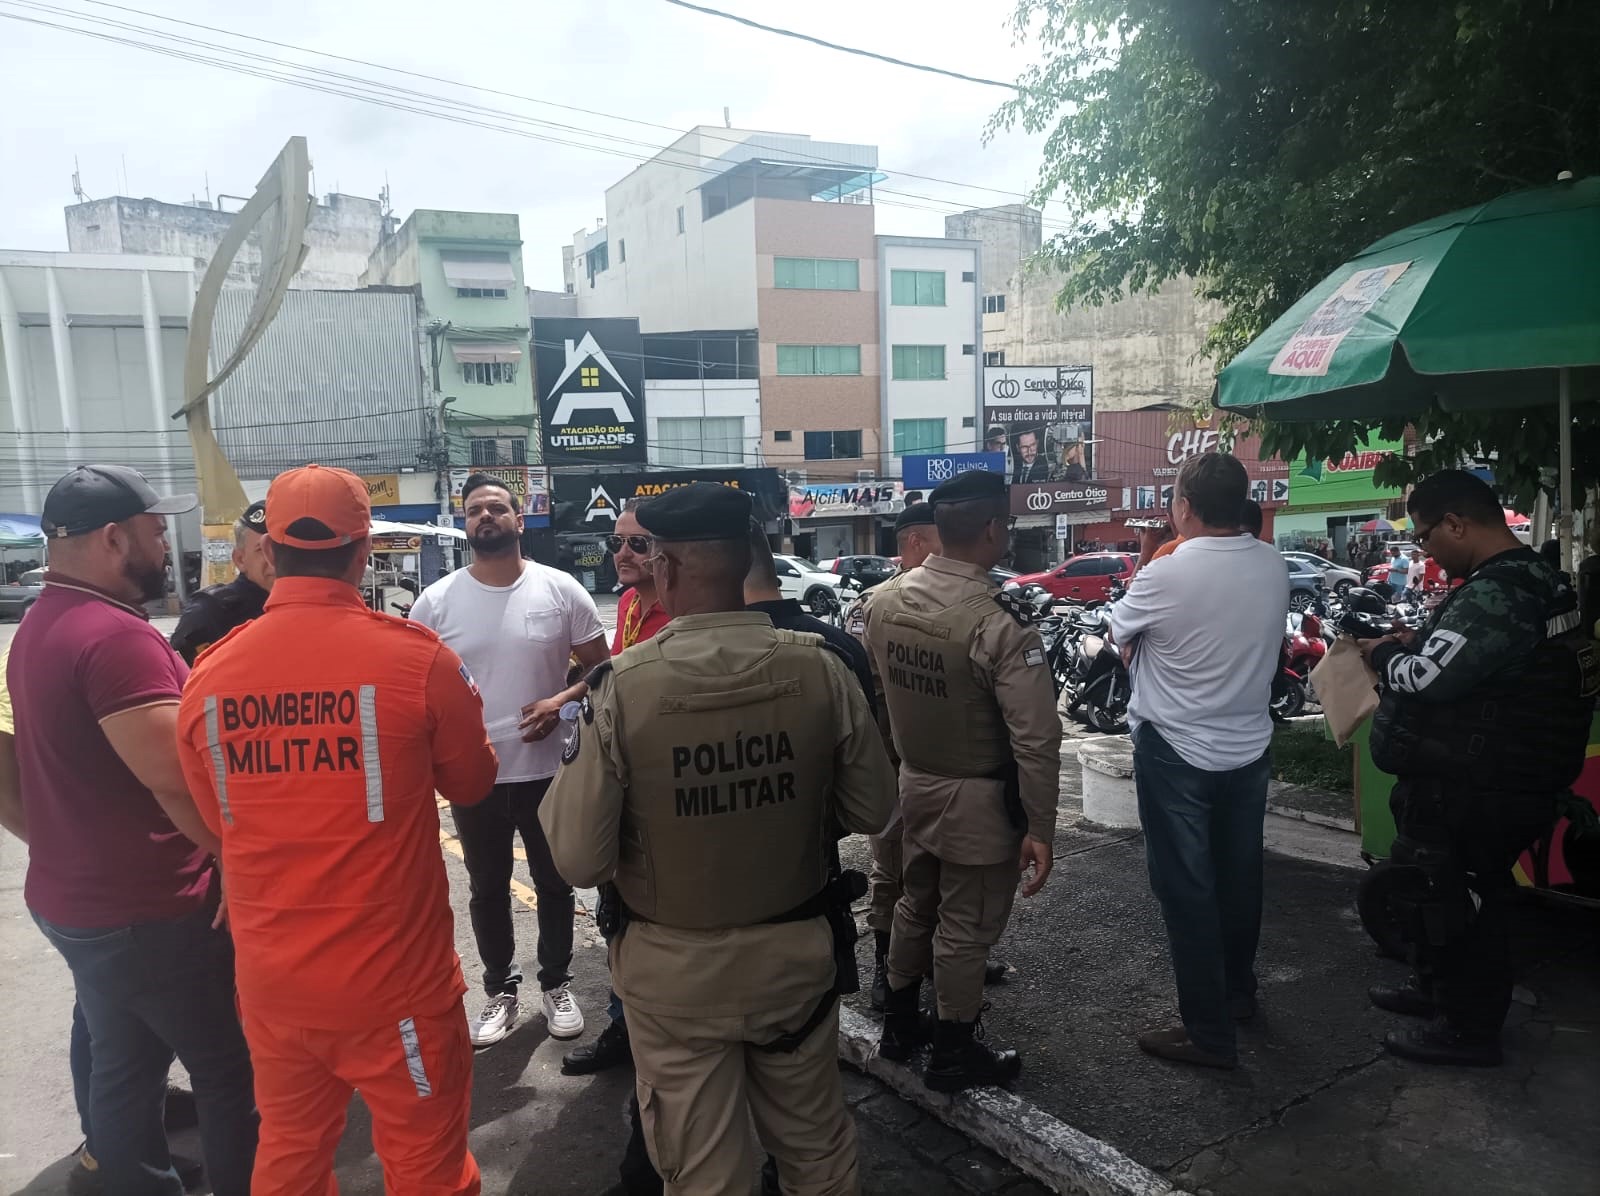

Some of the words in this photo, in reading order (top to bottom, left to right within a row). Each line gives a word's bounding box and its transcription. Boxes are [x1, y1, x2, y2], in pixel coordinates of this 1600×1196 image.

[1024, 378, 1056, 389] Centro
[991, 410, 997, 422] A
[998, 411, 1012, 421] sua
[1014, 408, 1033, 421] ótica
[1034, 412, 1040, 421] a
[560, 425, 607, 435] ATACADÃO
[608, 425, 626, 433] DAS
[550, 433, 635, 447] UTILIDADES
[927, 458, 953, 471] PRO
[957, 460, 989, 470] CLÍNICA
[927, 469, 953, 480] ENDO
[840, 486, 894, 504] MAIS
[1054, 489, 1083, 500] Centro
[1085, 486, 1107, 498] Ótico
[887, 640, 945, 674] POLÍCIA
[887, 664, 949, 699] MILITAR
[222, 689, 356, 731] BOMBEIRO
[226, 736, 361, 775] MILITAR
[672, 730, 795, 778] POLÍCIA
[674, 771, 797, 817] MILITAR
